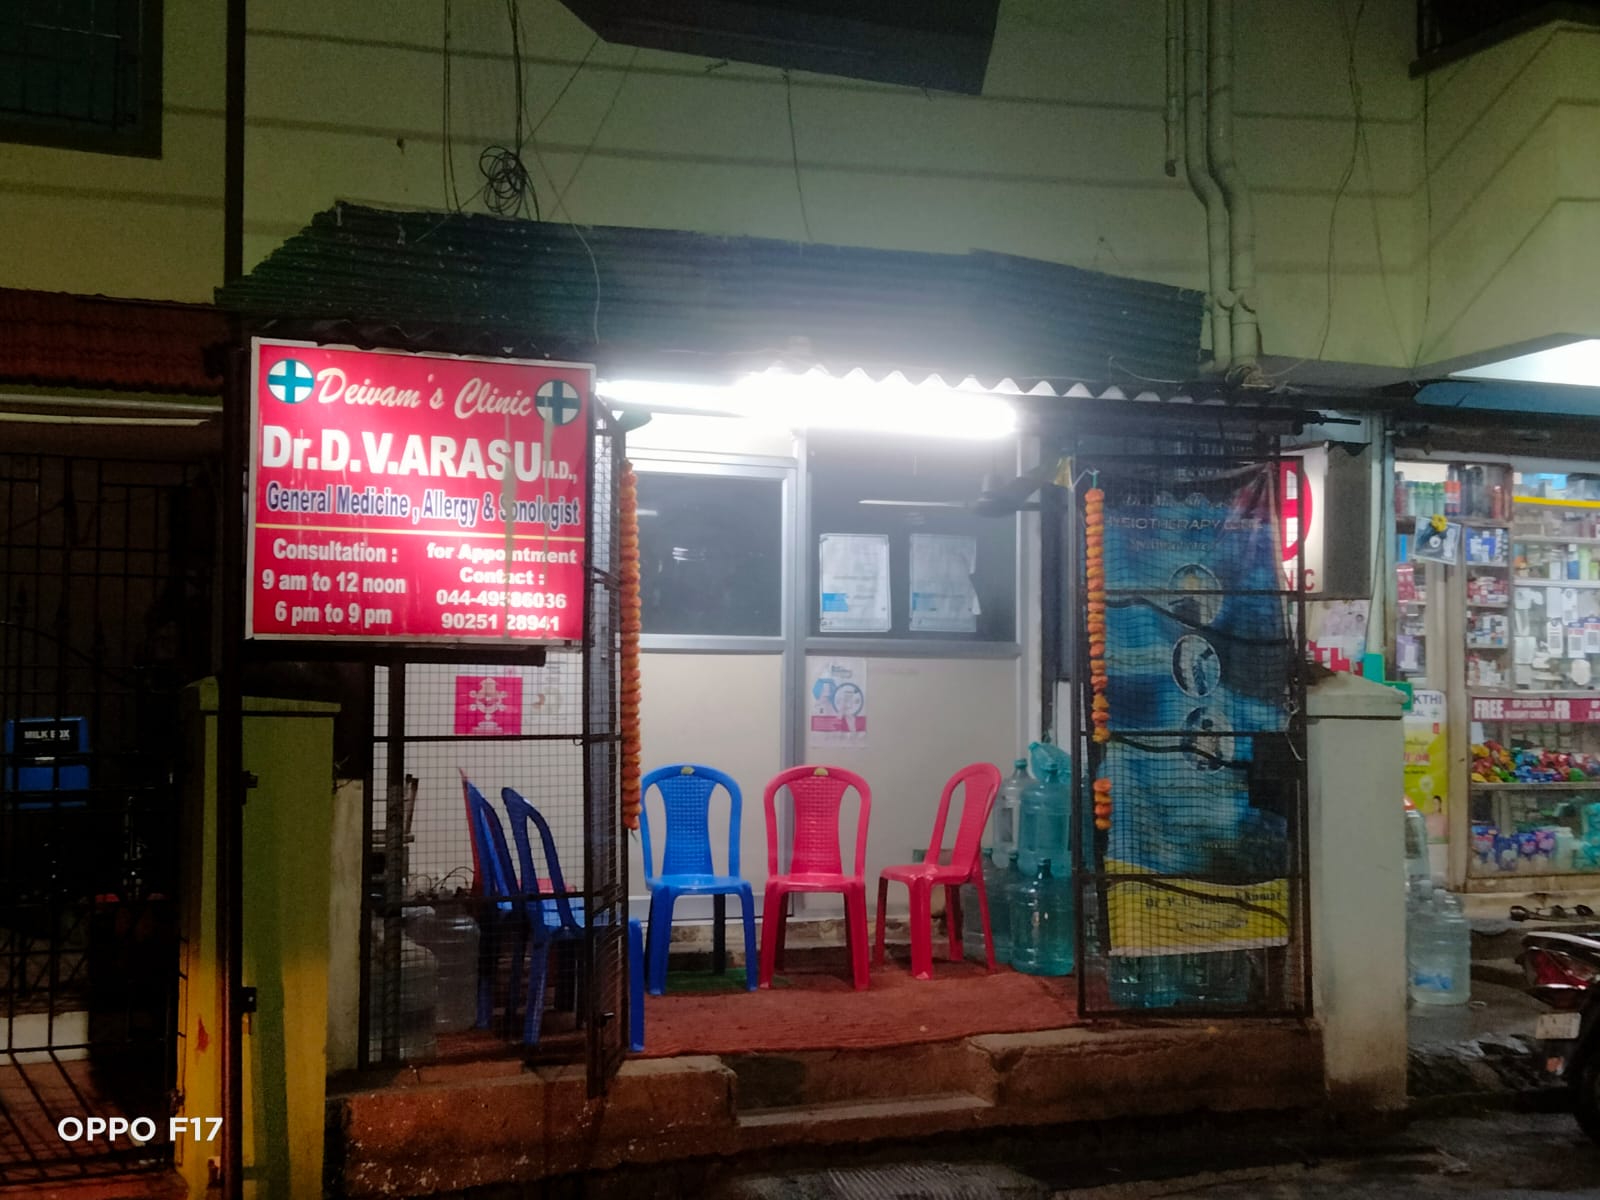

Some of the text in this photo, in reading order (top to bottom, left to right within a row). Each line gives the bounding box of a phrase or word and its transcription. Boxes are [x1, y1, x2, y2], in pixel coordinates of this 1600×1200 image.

[454, 377, 532, 420] Clinic
[262, 425, 541, 482] Dr.D.V.ARASU
[266, 480, 332, 513] General
[422, 489, 478, 528] Allergy
[482, 491, 495, 521] &
[273, 538, 387, 563] Consultation
[427, 542, 577, 564] for Appontment
[262, 569, 406, 593] 9 am to 12 noon
[275, 601, 392, 629] 6 pm to 9 pm
[441, 612, 560, 631] 90251 28941
[1474, 699, 1505, 719] FREE
[24, 730, 49, 739] MILK
